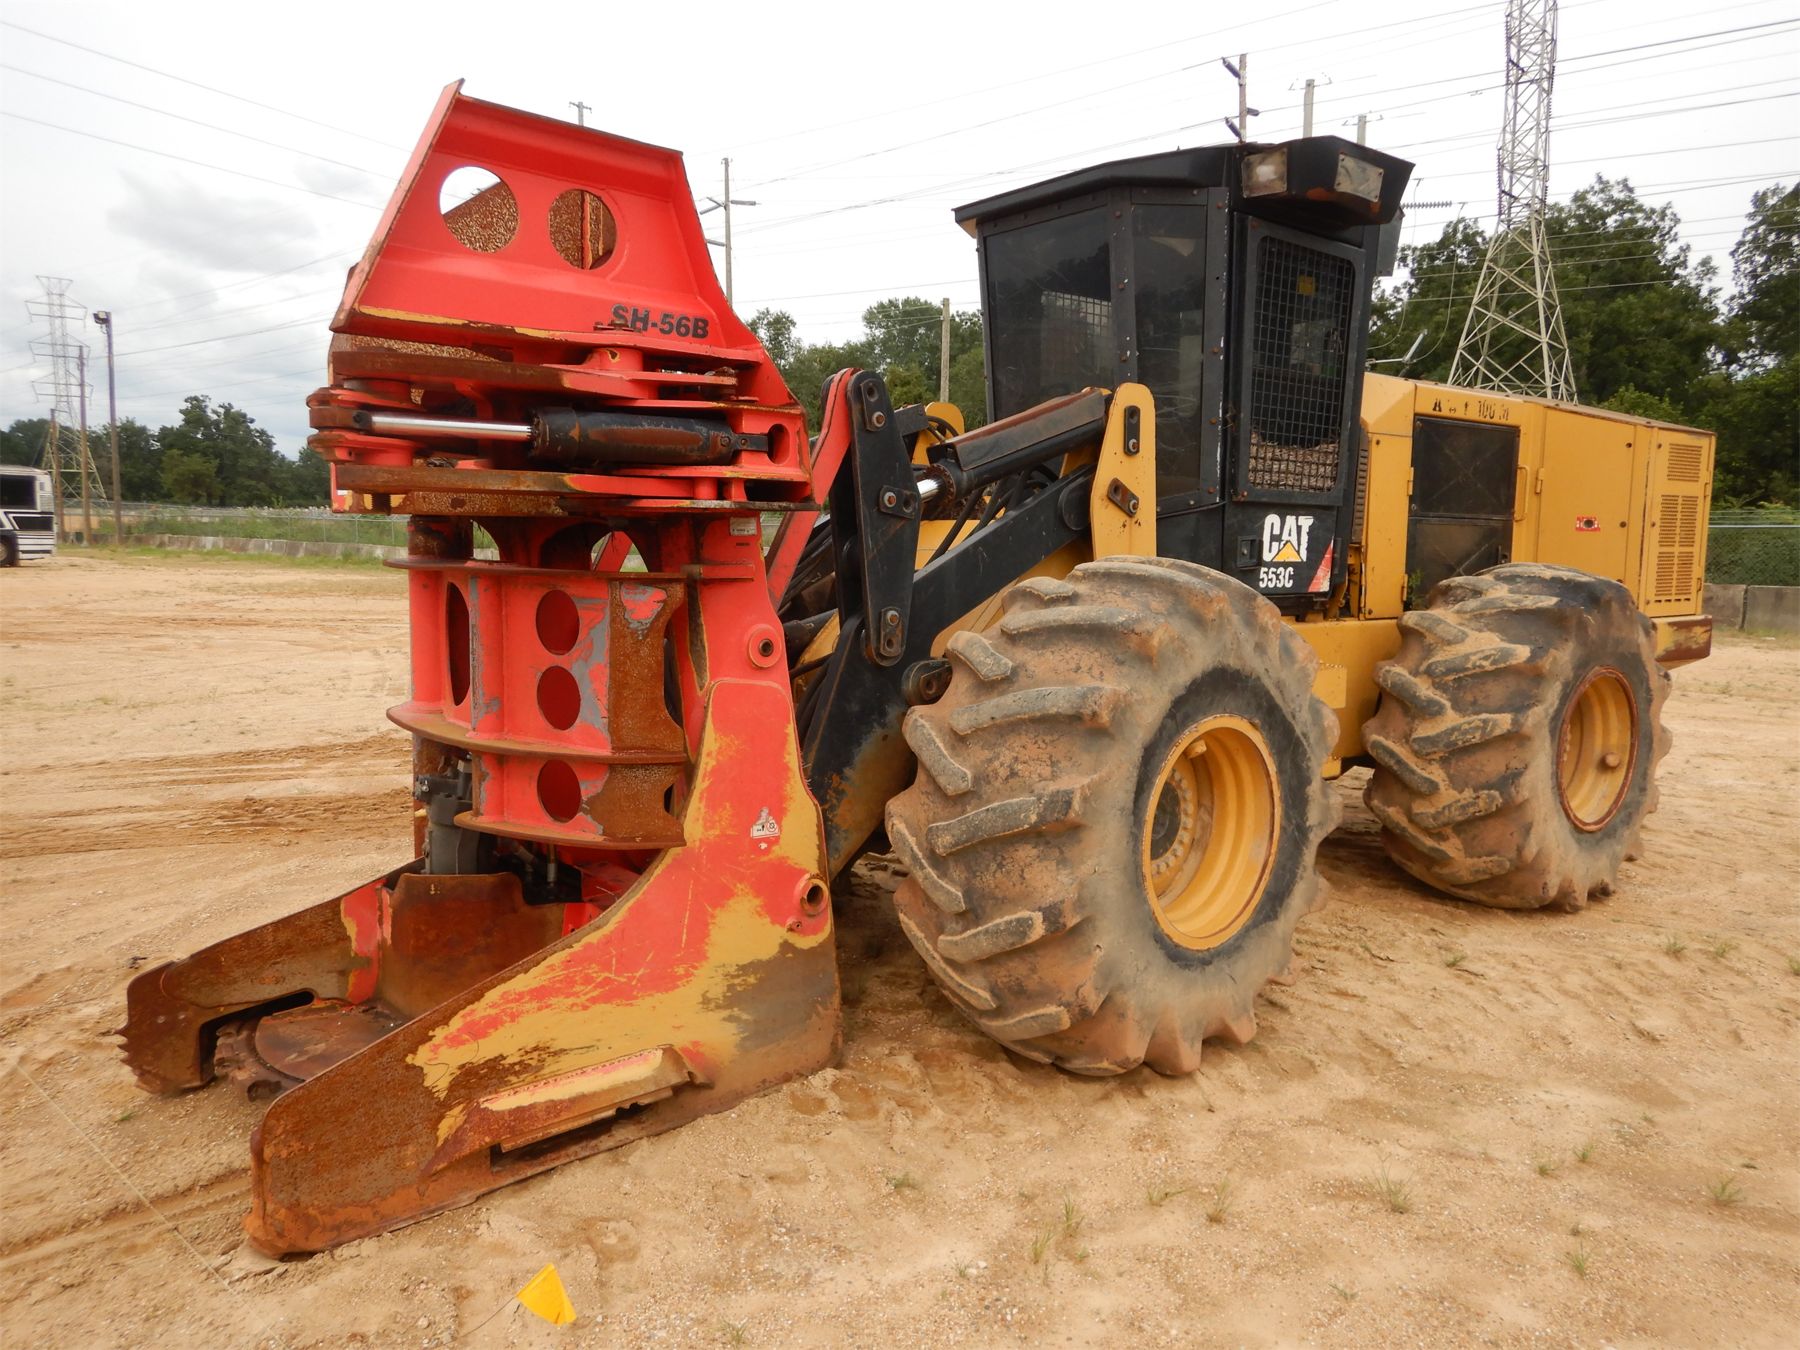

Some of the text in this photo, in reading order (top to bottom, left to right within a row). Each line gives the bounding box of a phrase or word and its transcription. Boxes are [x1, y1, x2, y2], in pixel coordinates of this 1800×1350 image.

[611, 304, 709, 338] SH-56B
[1262, 513, 1314, 562] CAT
[1259, 566, 1294, 588] 553C
